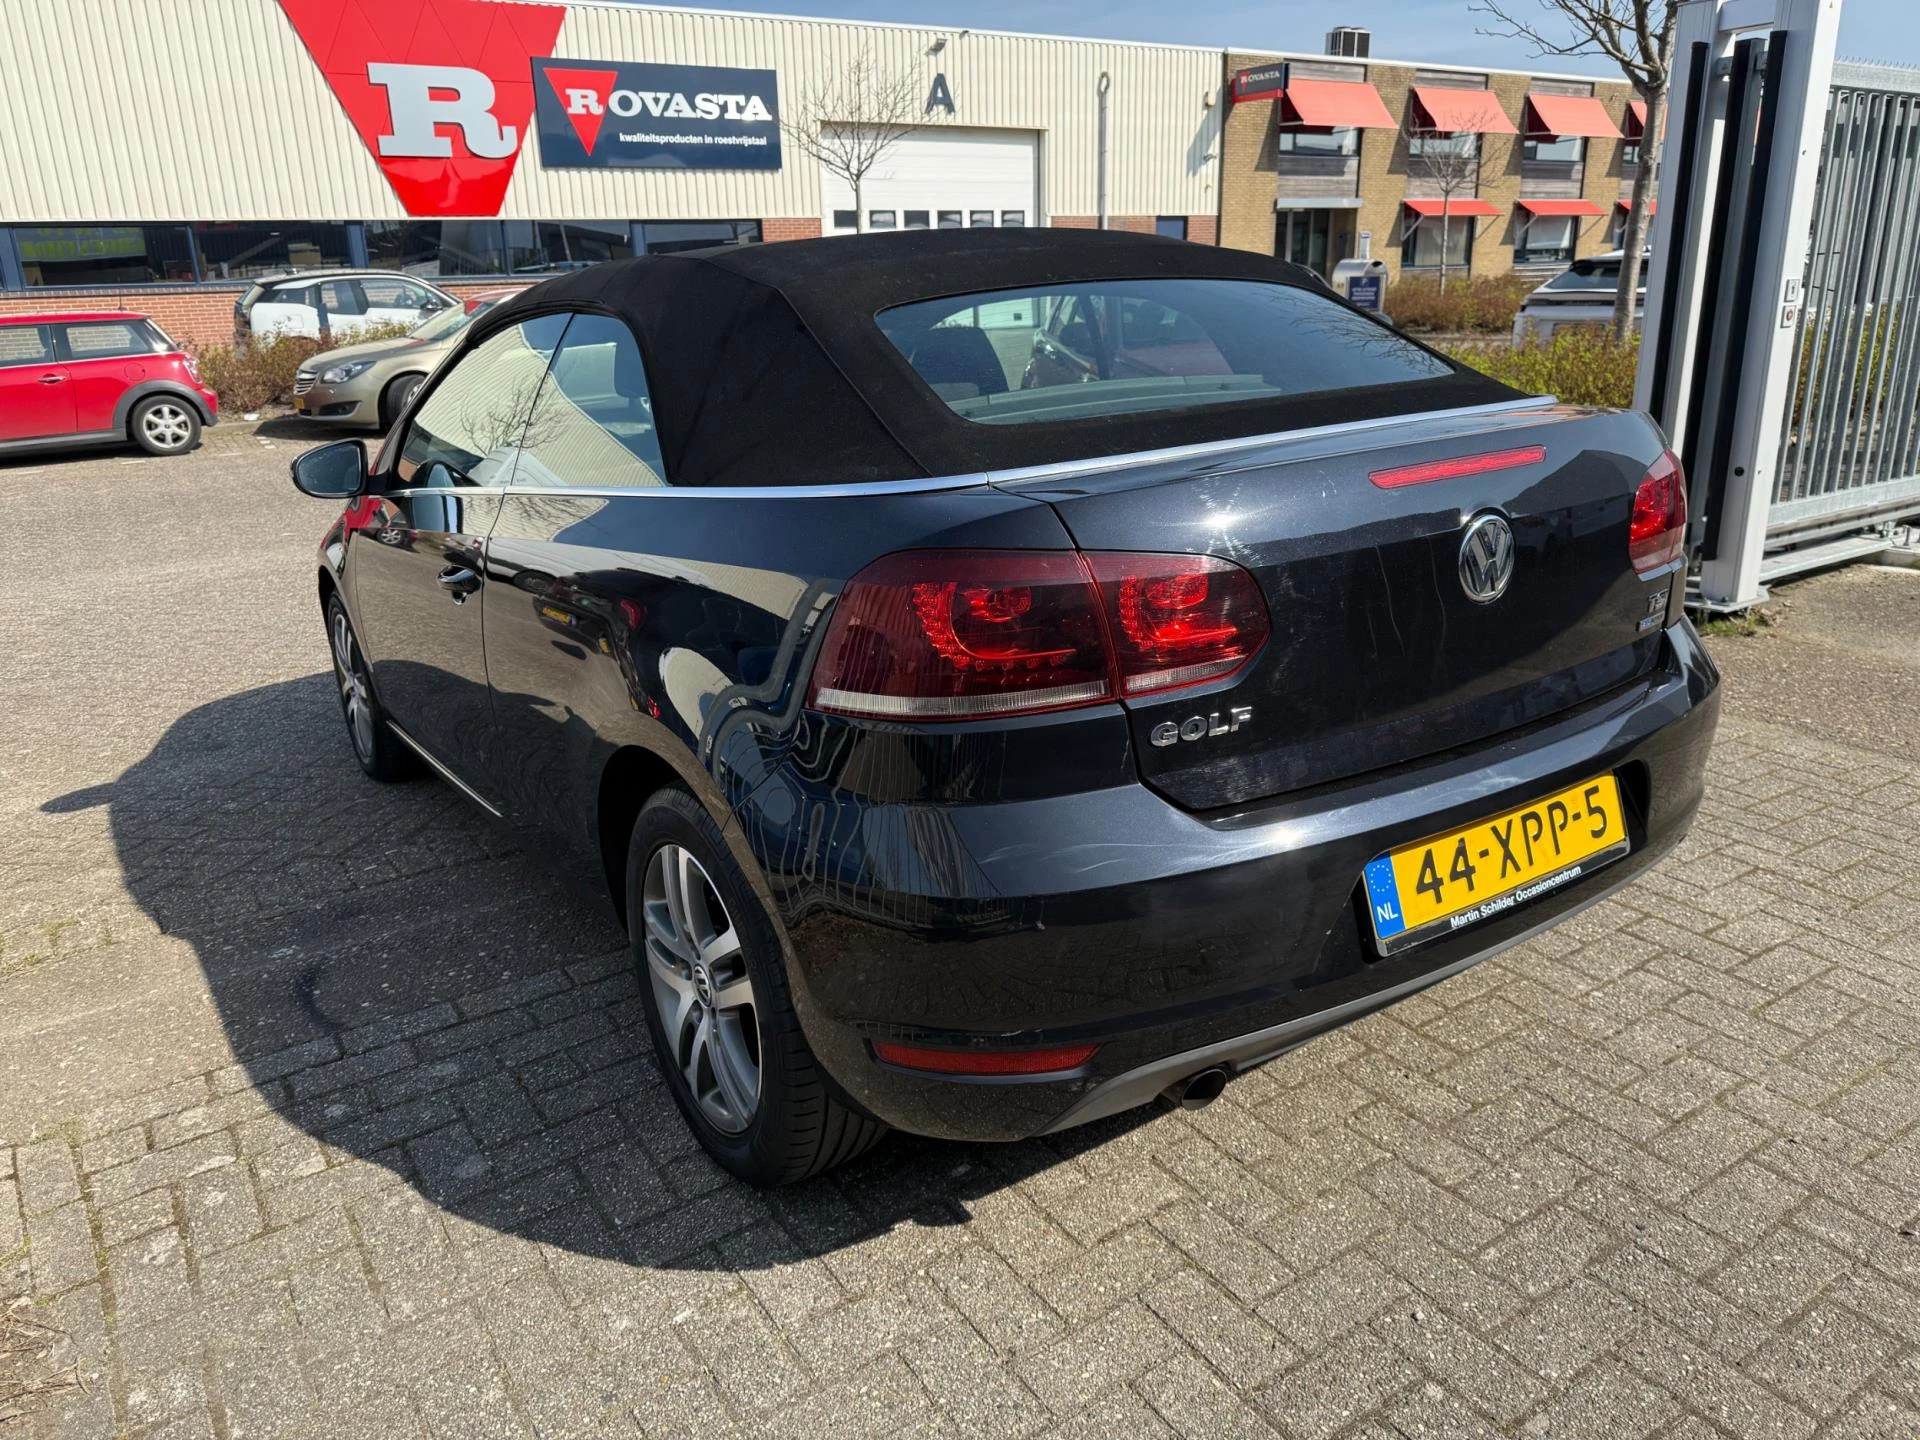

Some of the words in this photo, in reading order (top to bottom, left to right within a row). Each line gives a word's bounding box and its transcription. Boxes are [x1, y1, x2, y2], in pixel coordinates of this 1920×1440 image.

[924, 73, 956, 115] A
[1240, 70, 1280, 84] ROVASTA
[367, 62, 518, 159] R
[565, 88, 773, 121] ROVASTA
[619, 132, 703, 144] kwaliteitsproducten
[704, 134, 713, 144] in
[714, 135, 767, 147] roestvrijstaal
[1150, 706, 1252, 747] GOLF
[1415, 785, 1608, 904] 44-XPP-5
[1376, 902, 1399, 923] NL
[1450, 909, 1480, 928] Martin
[1480, 895, 1515, 916] Schilder
[1515, 866, 1581, 901] Occasioncentrum
